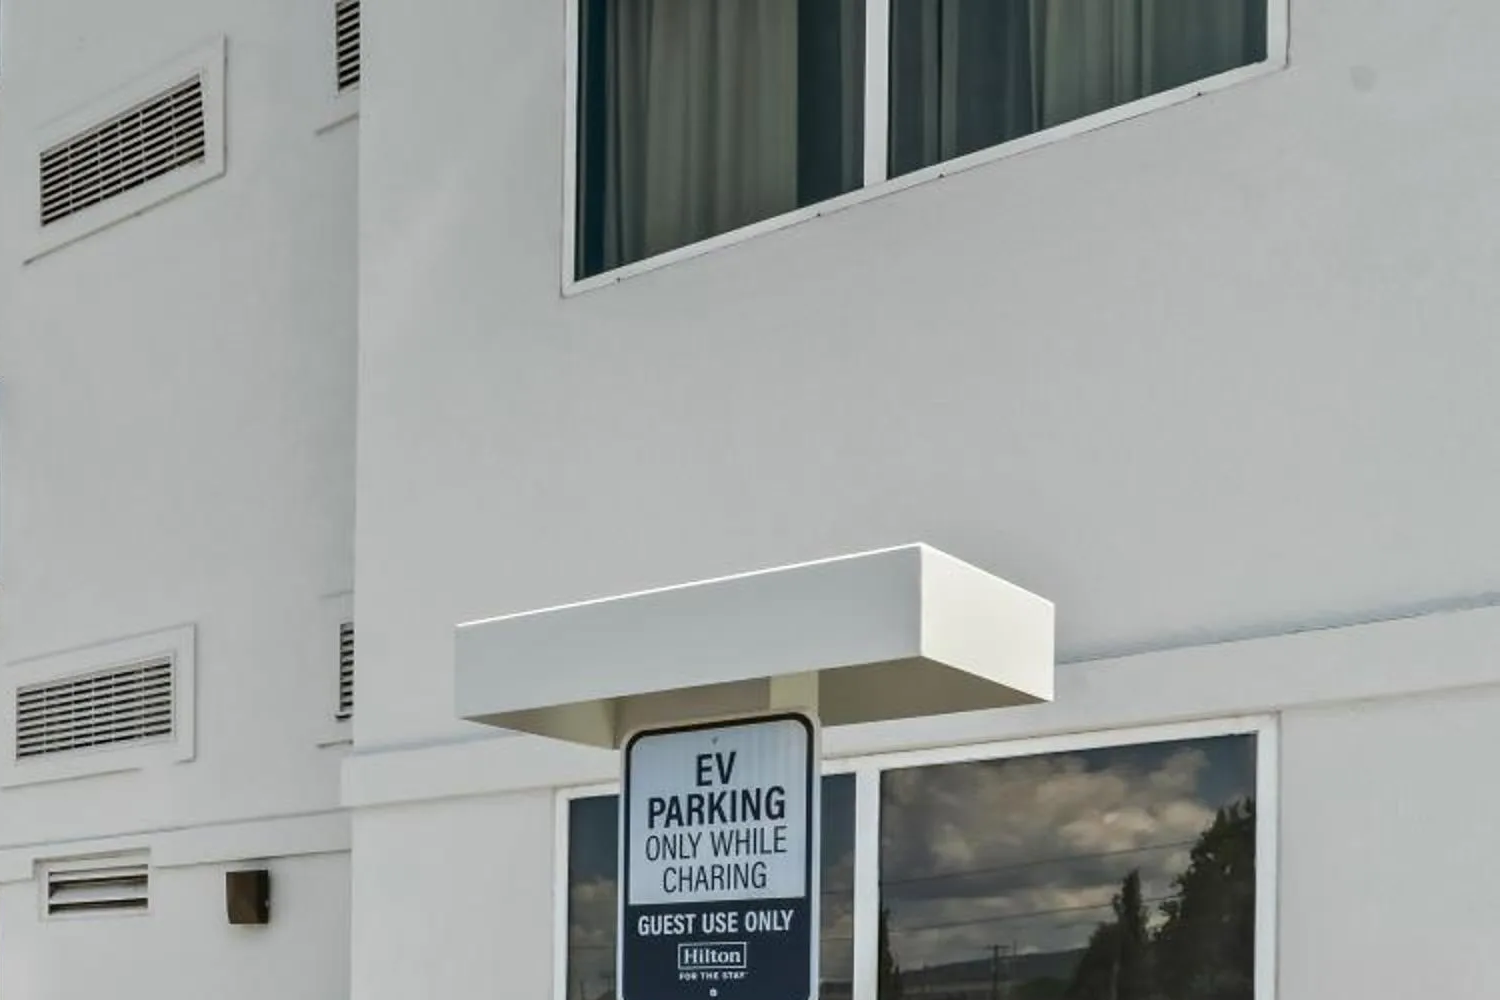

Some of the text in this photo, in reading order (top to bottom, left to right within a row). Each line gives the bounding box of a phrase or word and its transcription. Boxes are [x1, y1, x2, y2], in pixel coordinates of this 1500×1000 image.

[695, 751, 736, 787] EV
[647, 785, 786, 829] PARKING
[645, 825, 787, 861] ONLY WHILE
[663, 861, 768, 893] CHARING
[638, 909, 794, 936] GUEST USE ONLY
[684, 948, 741, 965] Hilton
[679, 971, 697, 981] FOR
[700, 971, 719, 980] THE
